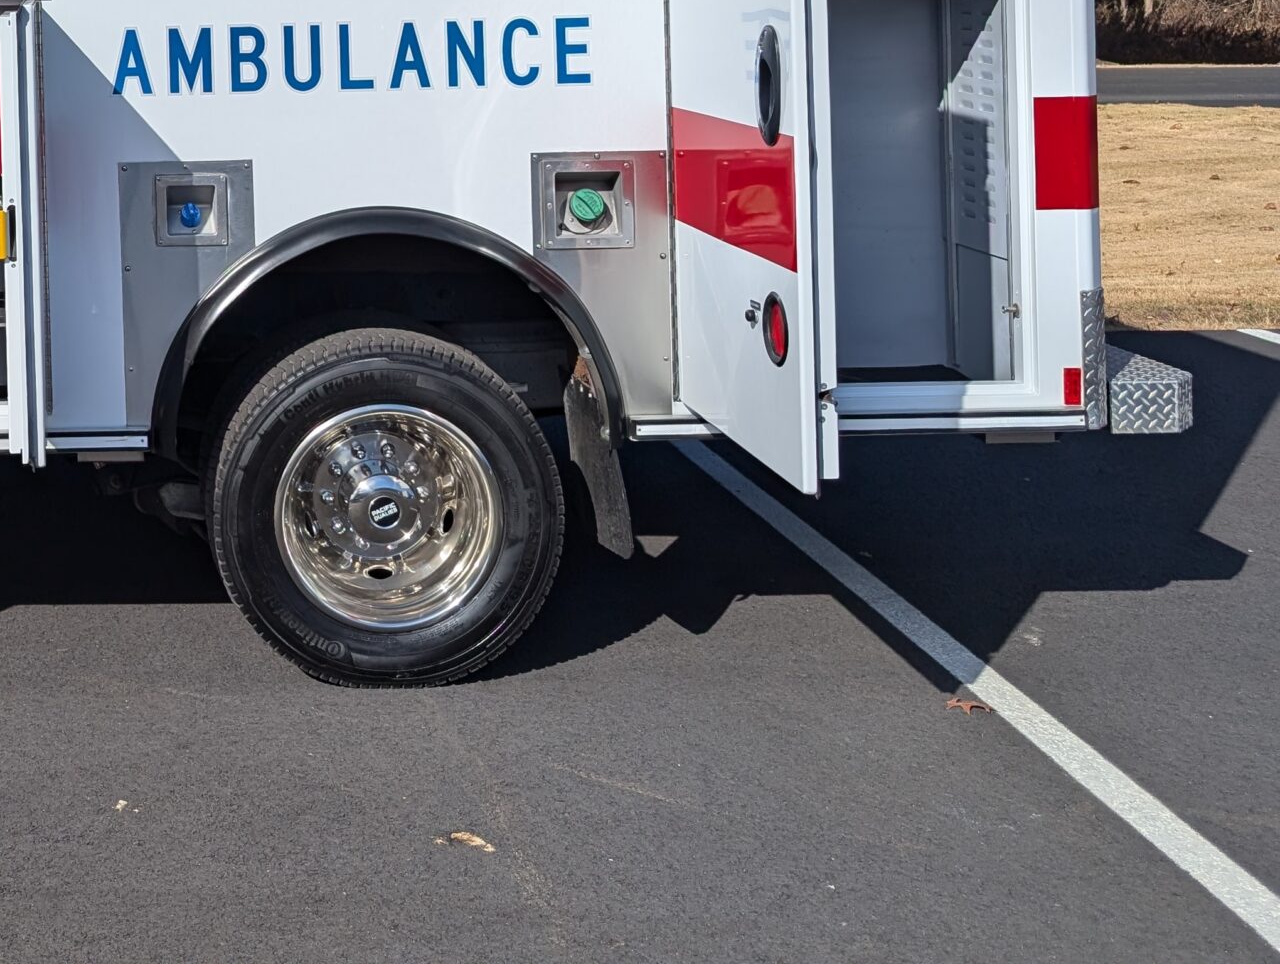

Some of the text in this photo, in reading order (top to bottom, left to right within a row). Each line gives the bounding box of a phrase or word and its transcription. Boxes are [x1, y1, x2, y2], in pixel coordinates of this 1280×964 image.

[111, 15, 593, 96] AMBULANCE
[283, 389, 322, 421] Conti
[322, 371, 376, 396] Hybrid
[371, 502, 396, 517] PACIFIC
